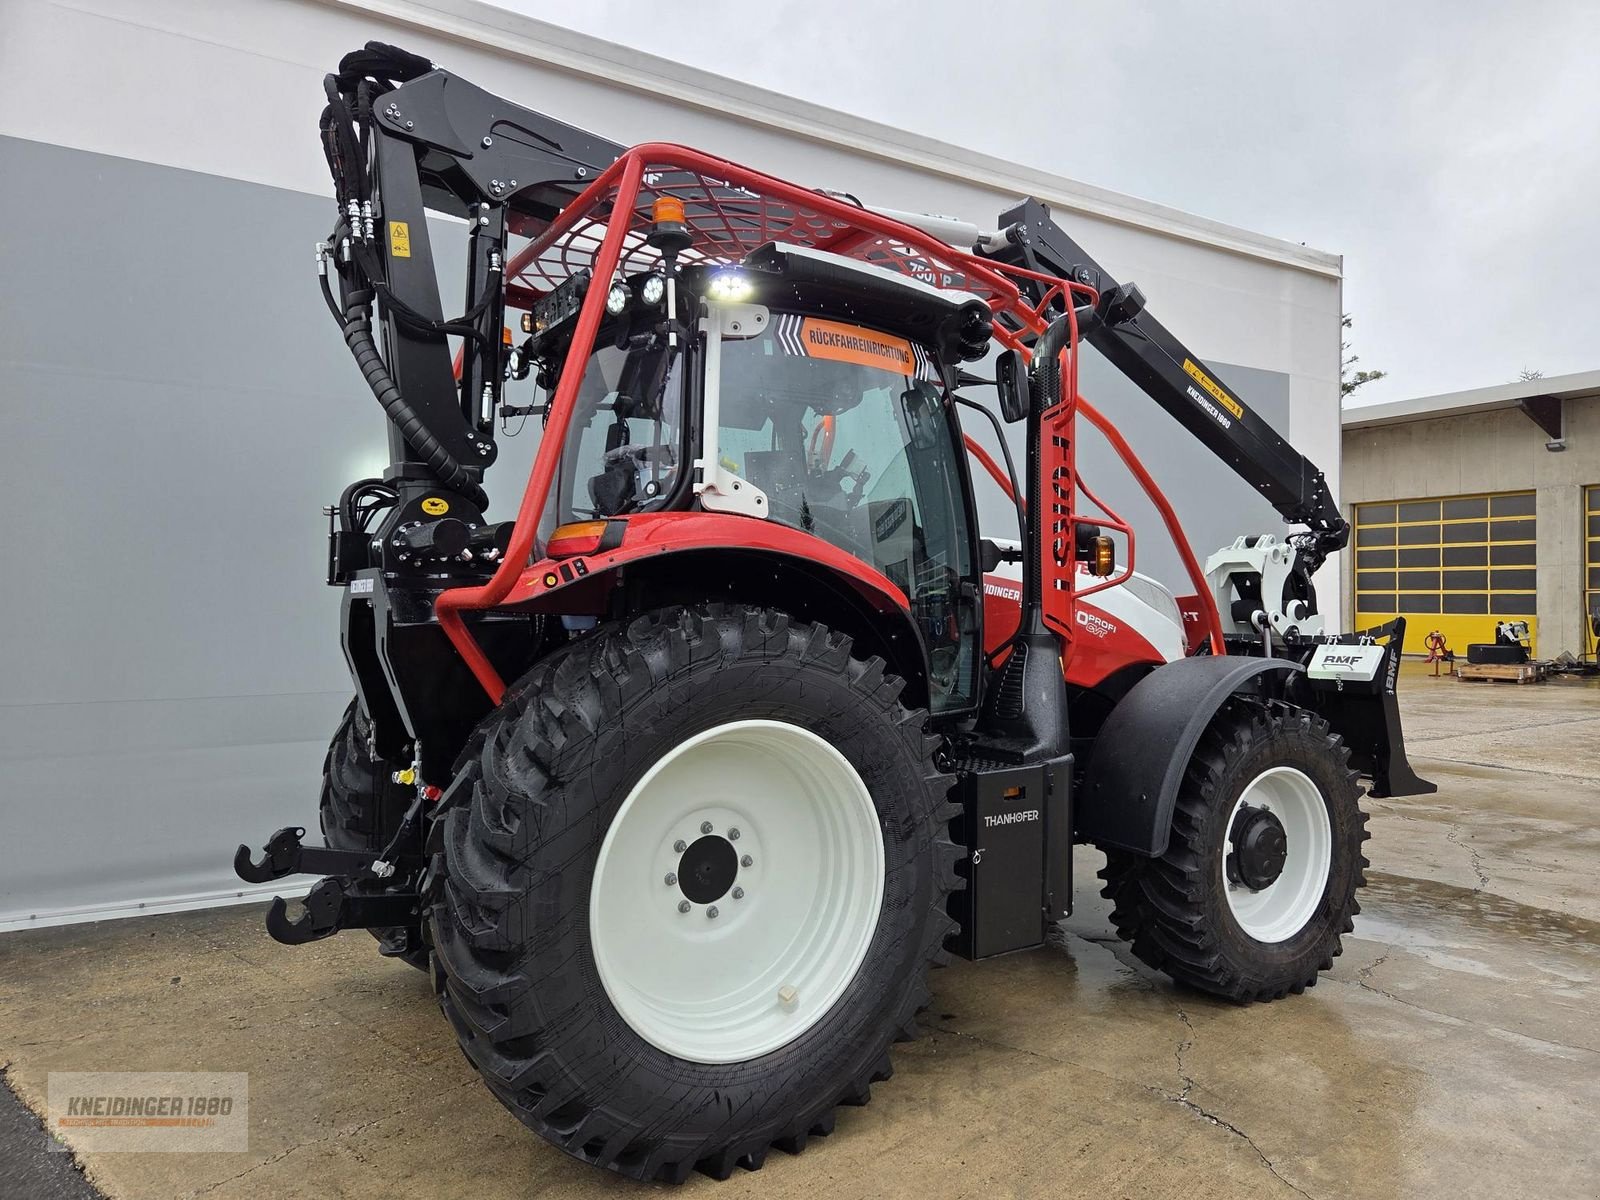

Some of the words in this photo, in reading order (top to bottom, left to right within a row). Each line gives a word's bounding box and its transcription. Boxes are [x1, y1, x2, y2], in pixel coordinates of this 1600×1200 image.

[809, 328, 910, 363] RÜCKFAHREINRICHTUNG
[1186, 385, 1219, 418] KNEIDINGER
[1088, 614, 1117, 633] PROFI
[1385, 648, 1398, 689] BMF
[984, 809, 1039, 827] THANHOFER
